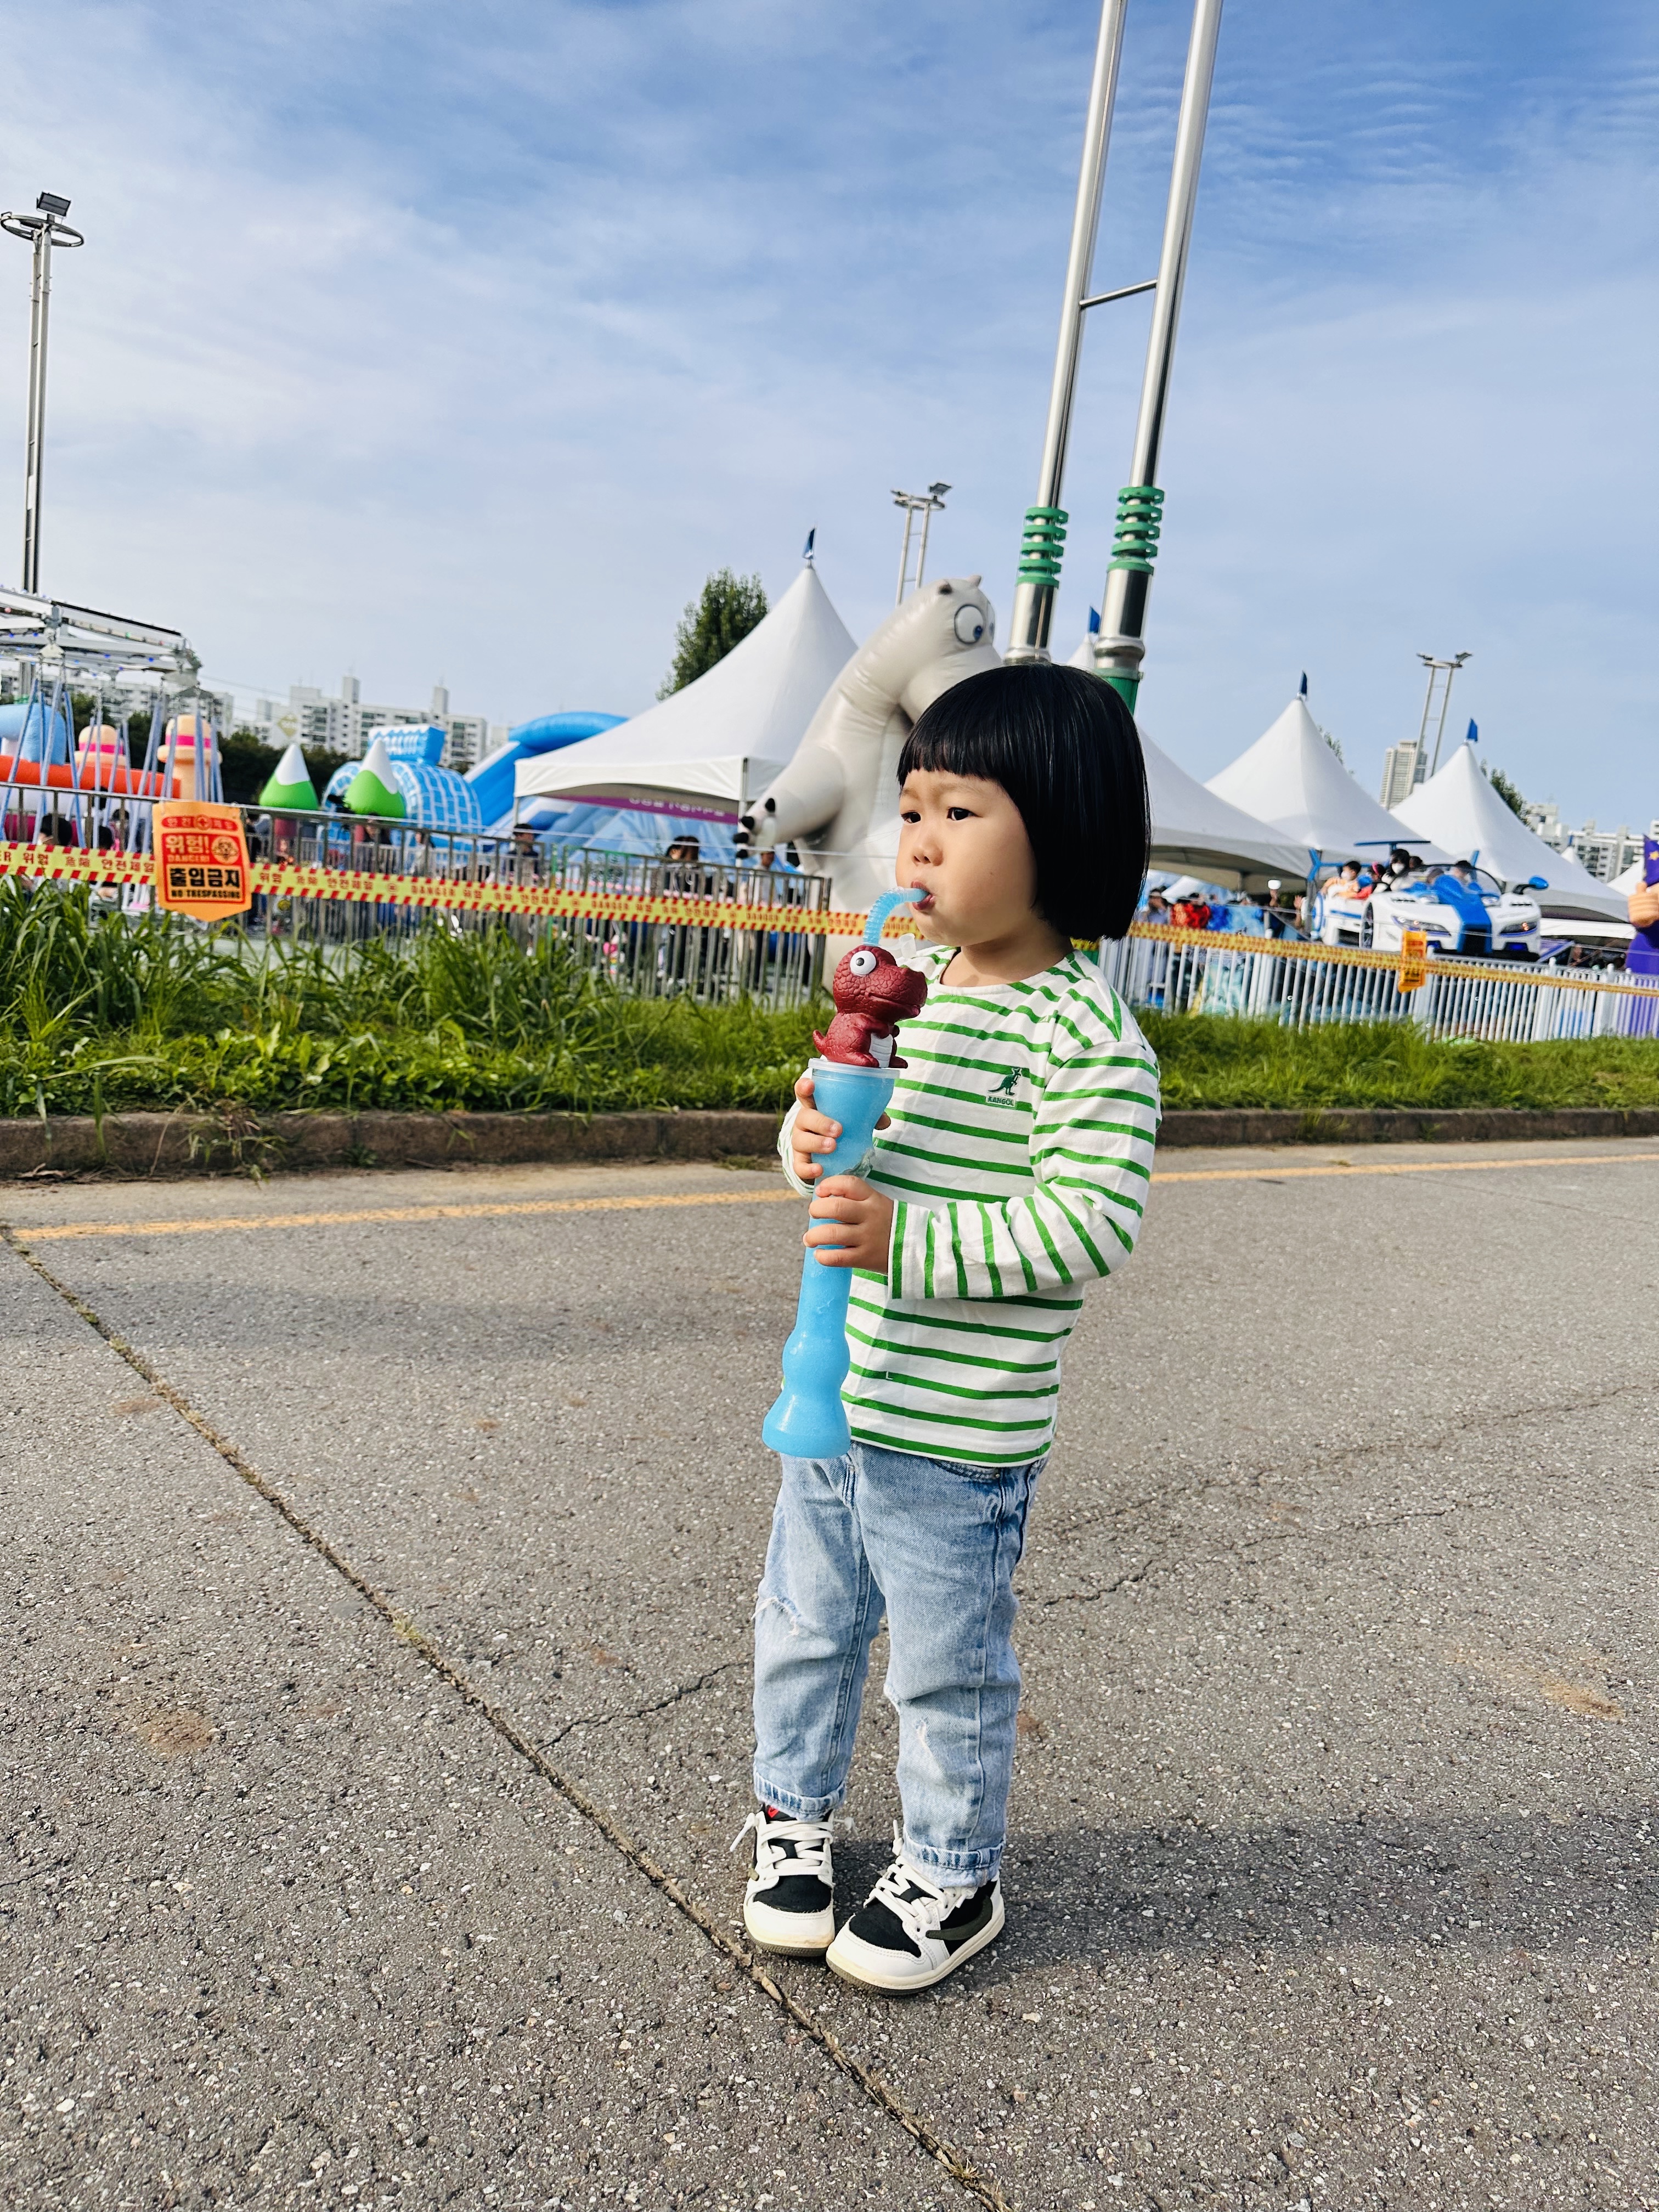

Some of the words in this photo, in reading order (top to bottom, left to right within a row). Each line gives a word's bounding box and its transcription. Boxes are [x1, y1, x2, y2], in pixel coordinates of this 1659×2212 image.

[165, 834, 209, 854] 위험!
[170, 868, 240, 888] 출입금지
[187, 890, 240, 898] TRESPASSING
[988, 1096, 1014, 1107] KANGOL
